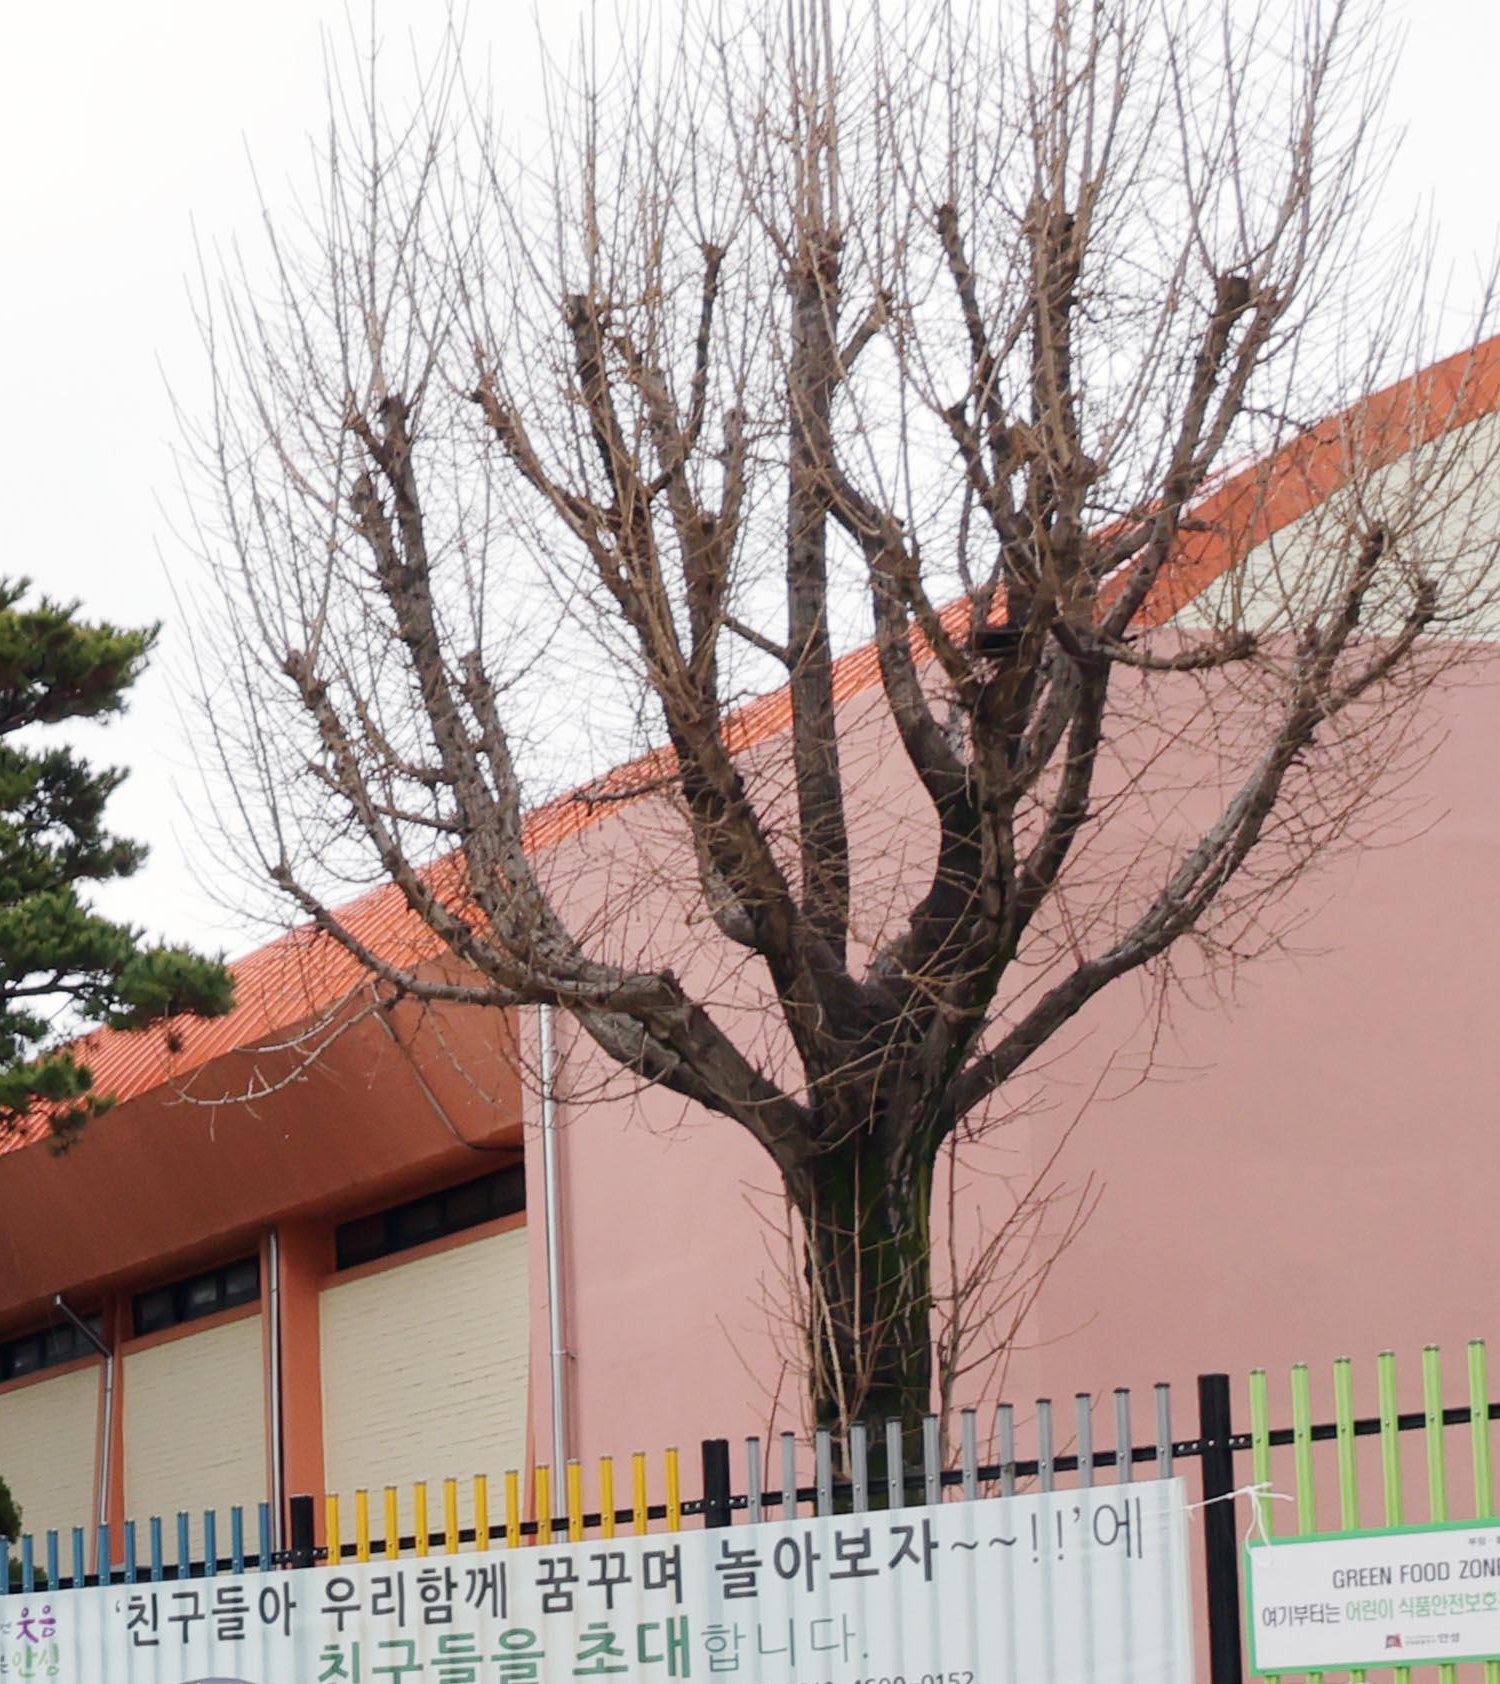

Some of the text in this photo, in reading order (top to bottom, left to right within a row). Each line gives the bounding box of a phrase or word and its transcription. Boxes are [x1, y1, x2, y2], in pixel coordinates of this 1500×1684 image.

[321, 1562, 508, 1631] 우리함께
[536, 1543, 683, 1614] 꿈꾸며
[1333, 1566, 1392, 1589] GREEN
[1400, 1561, 1450, 1584] FOOD
[16, 1605, 57, 1643] 웃음
[1262, 1591, 1500, 1628] 여기부터는 어린이 식품안전보호
[572, 1612, 870, 1679] 초대합니다.
